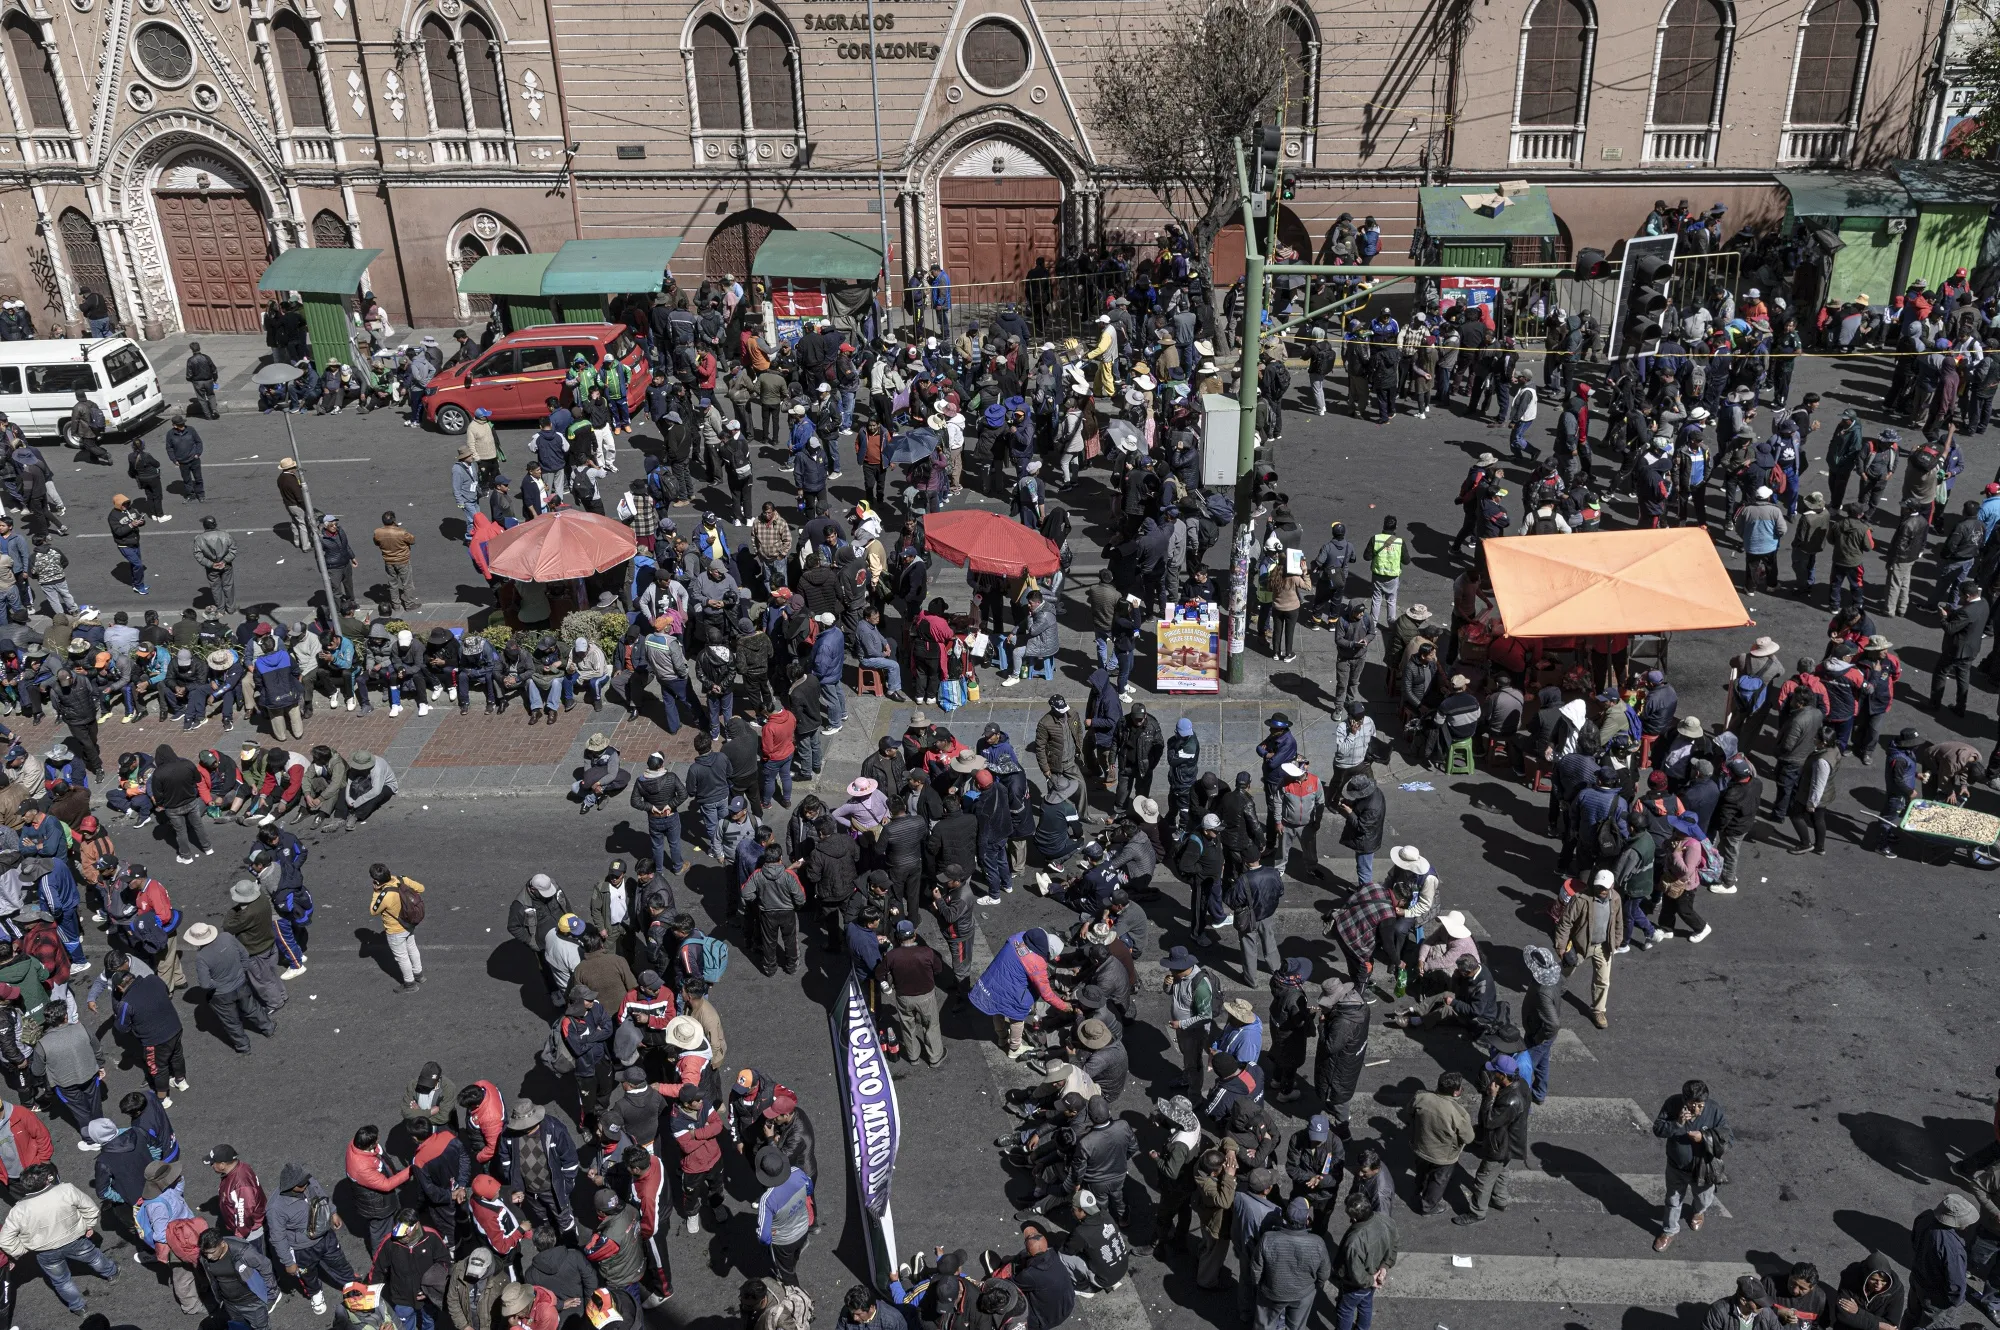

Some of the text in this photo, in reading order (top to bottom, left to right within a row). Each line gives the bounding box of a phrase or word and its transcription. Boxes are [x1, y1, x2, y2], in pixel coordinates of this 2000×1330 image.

[804, 13, 894, 30] SAGRADOS
[837, 41, 941, 61] CORAZONES
[861, 1100, 890, 1167] MIXTO
